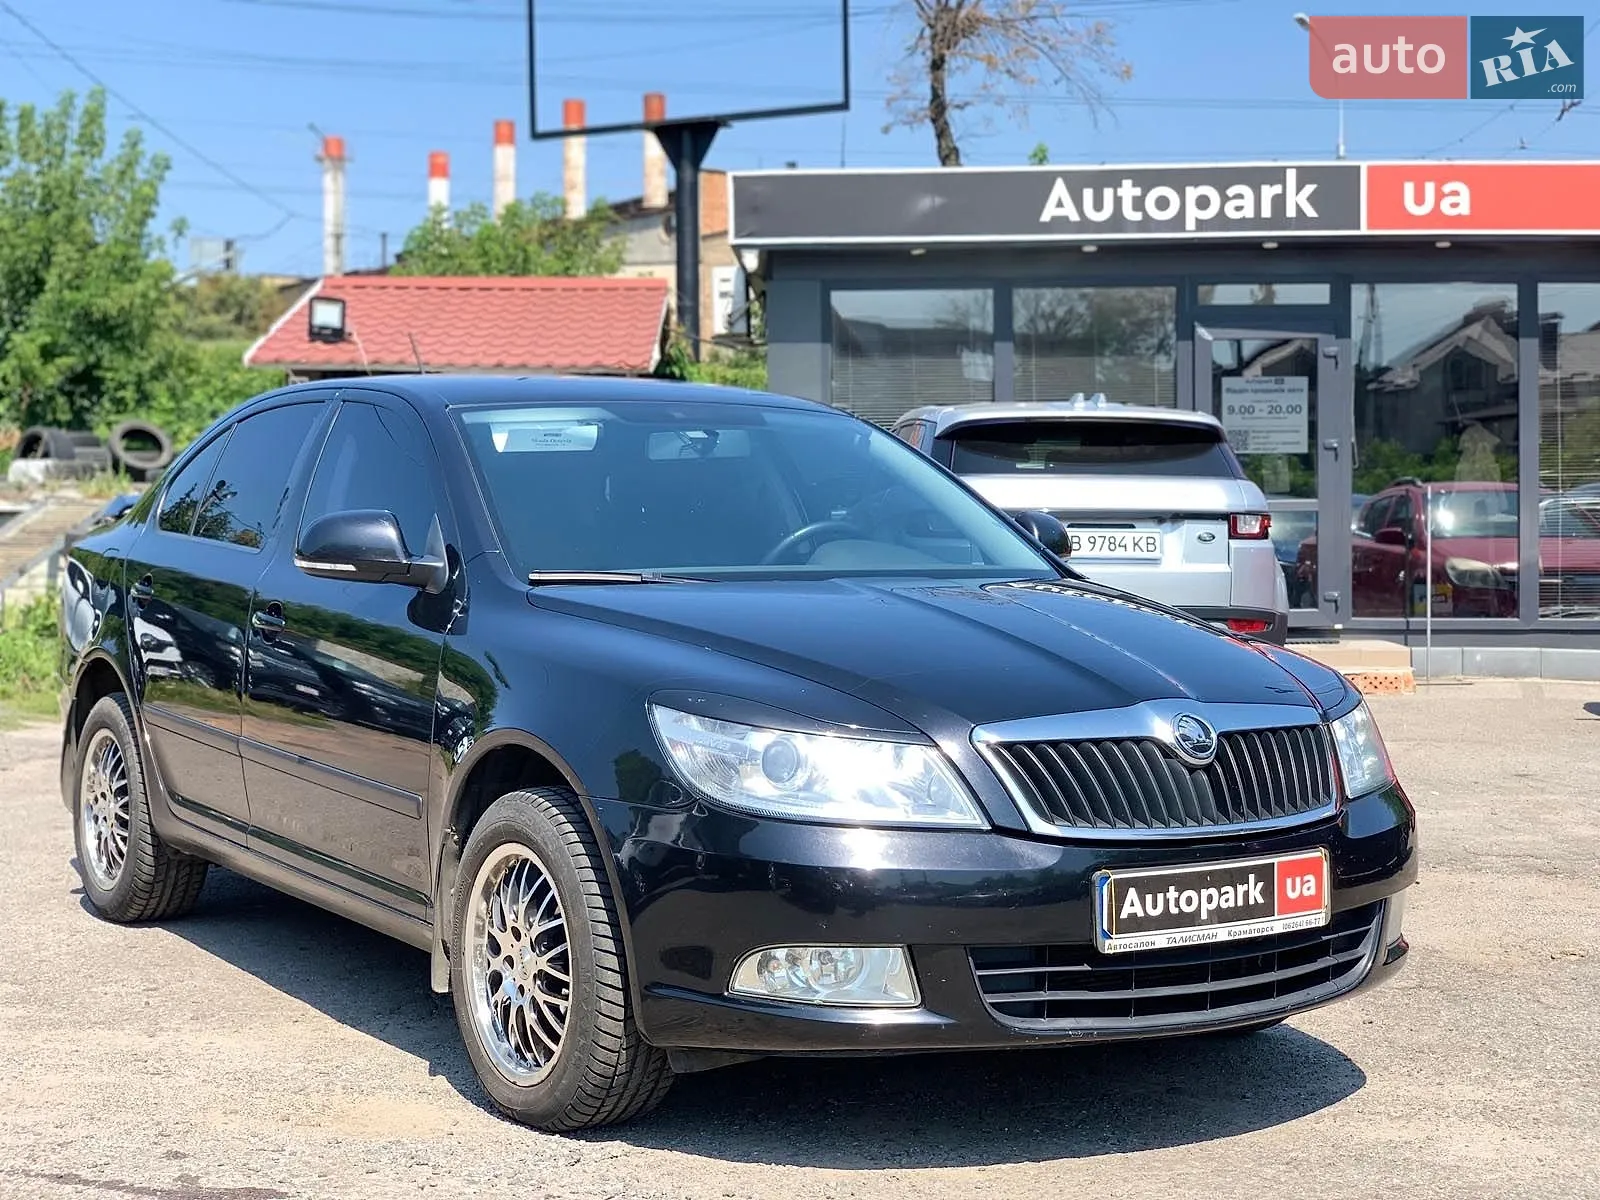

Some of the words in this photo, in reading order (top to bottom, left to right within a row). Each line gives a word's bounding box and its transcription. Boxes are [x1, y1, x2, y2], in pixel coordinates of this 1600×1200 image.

[1039, 168, 1319, 231] Autopark
[1403, 180, 1471, 217] ua
[1227, 404, 1256, 415] 9.00
[1267, 404, 1302, 415] 20.00
[1070, 535, 1082, 552] B
[1087, 535, 1128, 552] 9784
[1132, 535, 1157, 552] KB
[1119, 873, 1265, 920] Autopark
[1285, 873, 1316, 900] ua
[1107, 940, 1156, 952] Автосалон
[1166, 931, 1218, 946] ТАЛИСМАН
[1227, 925, 1275, 938] Краматорск
